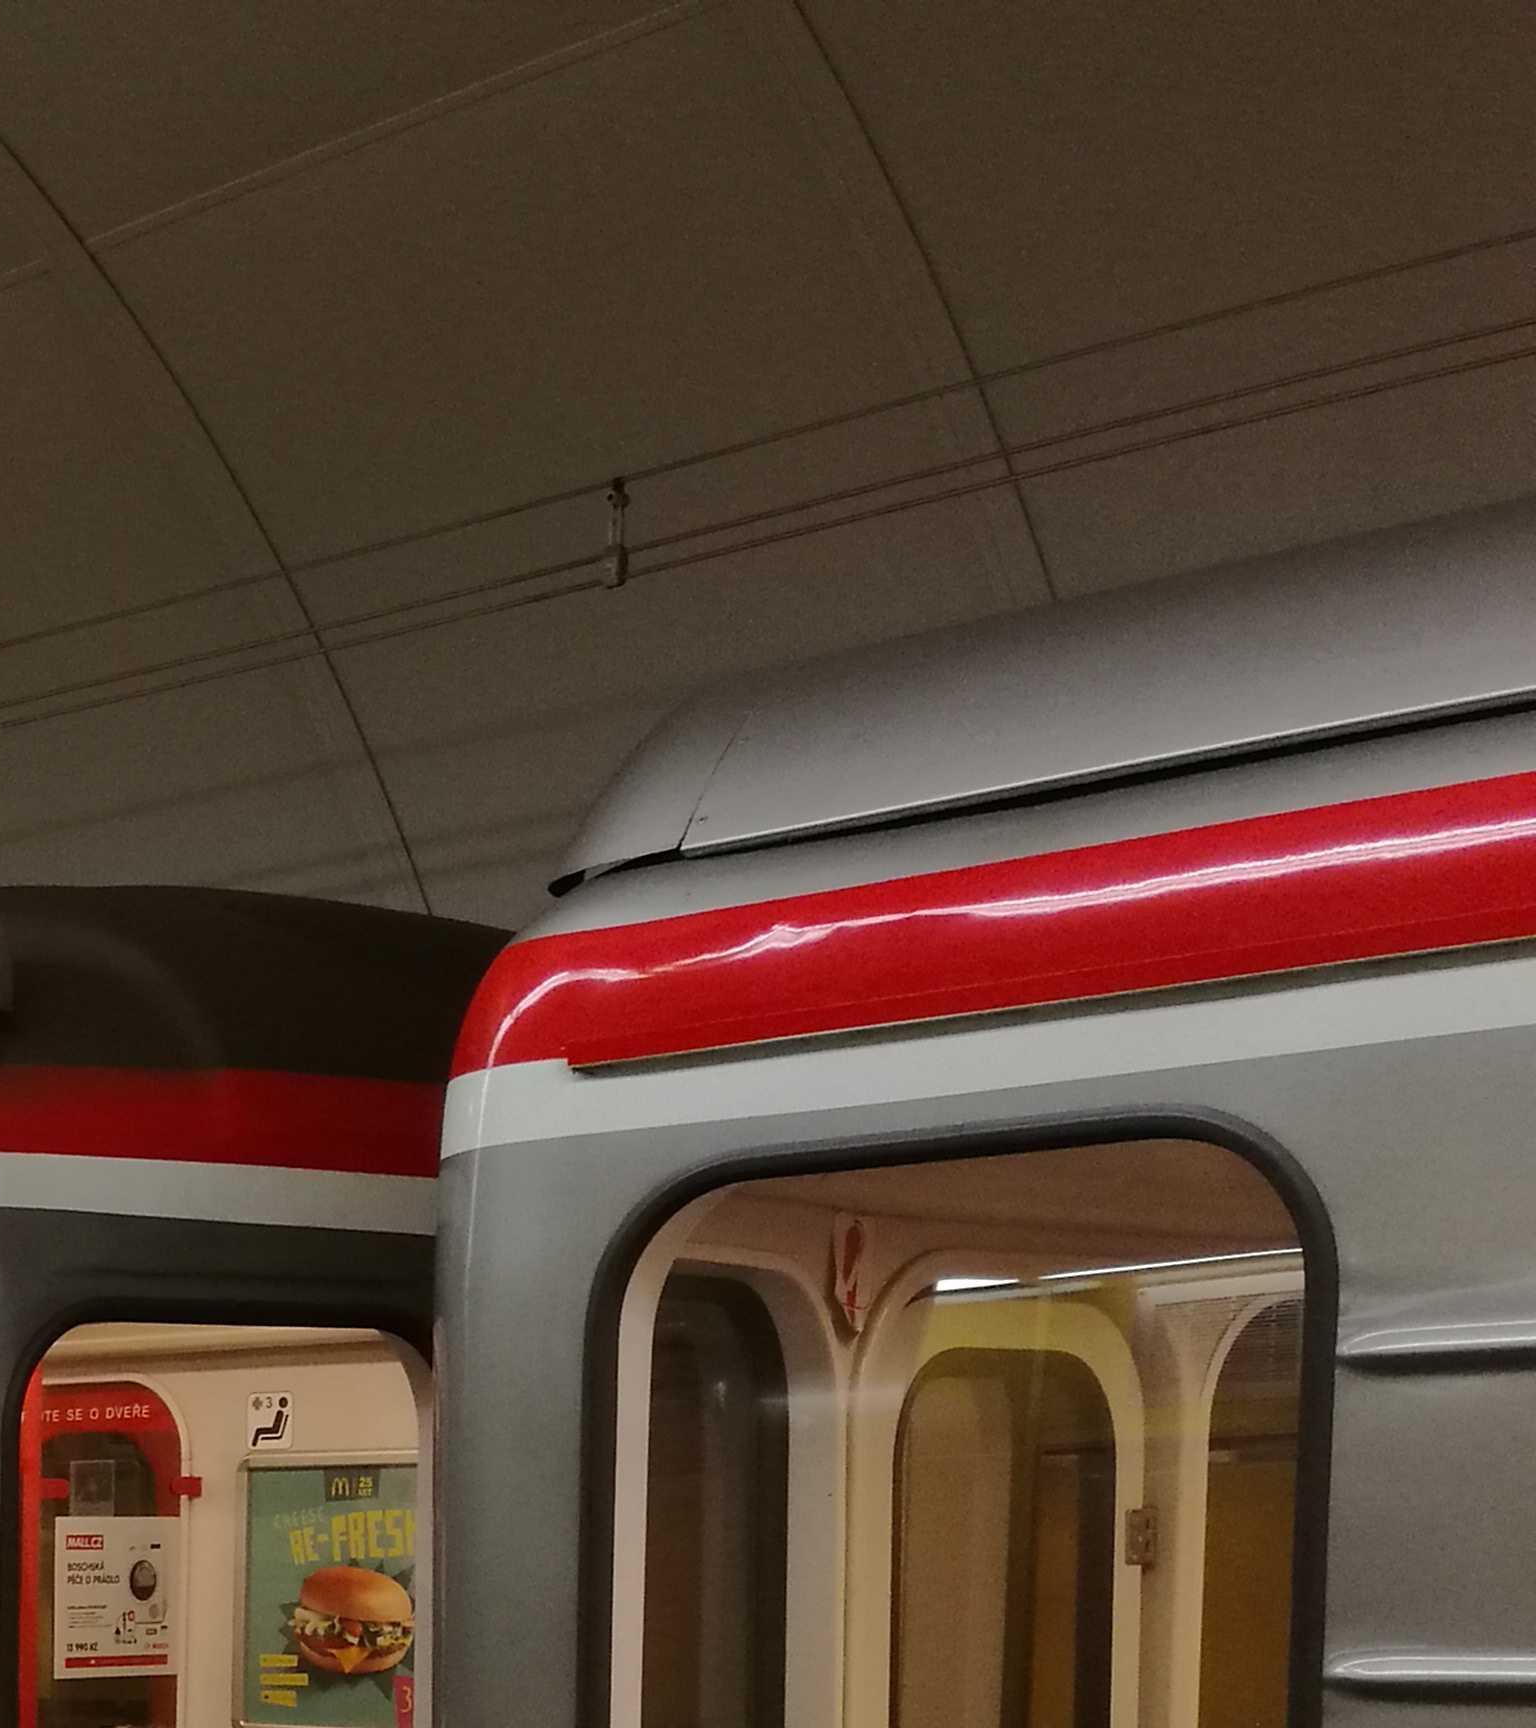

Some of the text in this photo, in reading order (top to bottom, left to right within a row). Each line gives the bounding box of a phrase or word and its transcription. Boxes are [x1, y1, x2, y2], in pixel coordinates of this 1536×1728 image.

[66, 1408, 83, 1421] SE
[89, 1407, 99, 1420] O
[358, 1476, 373, 1488] 25
